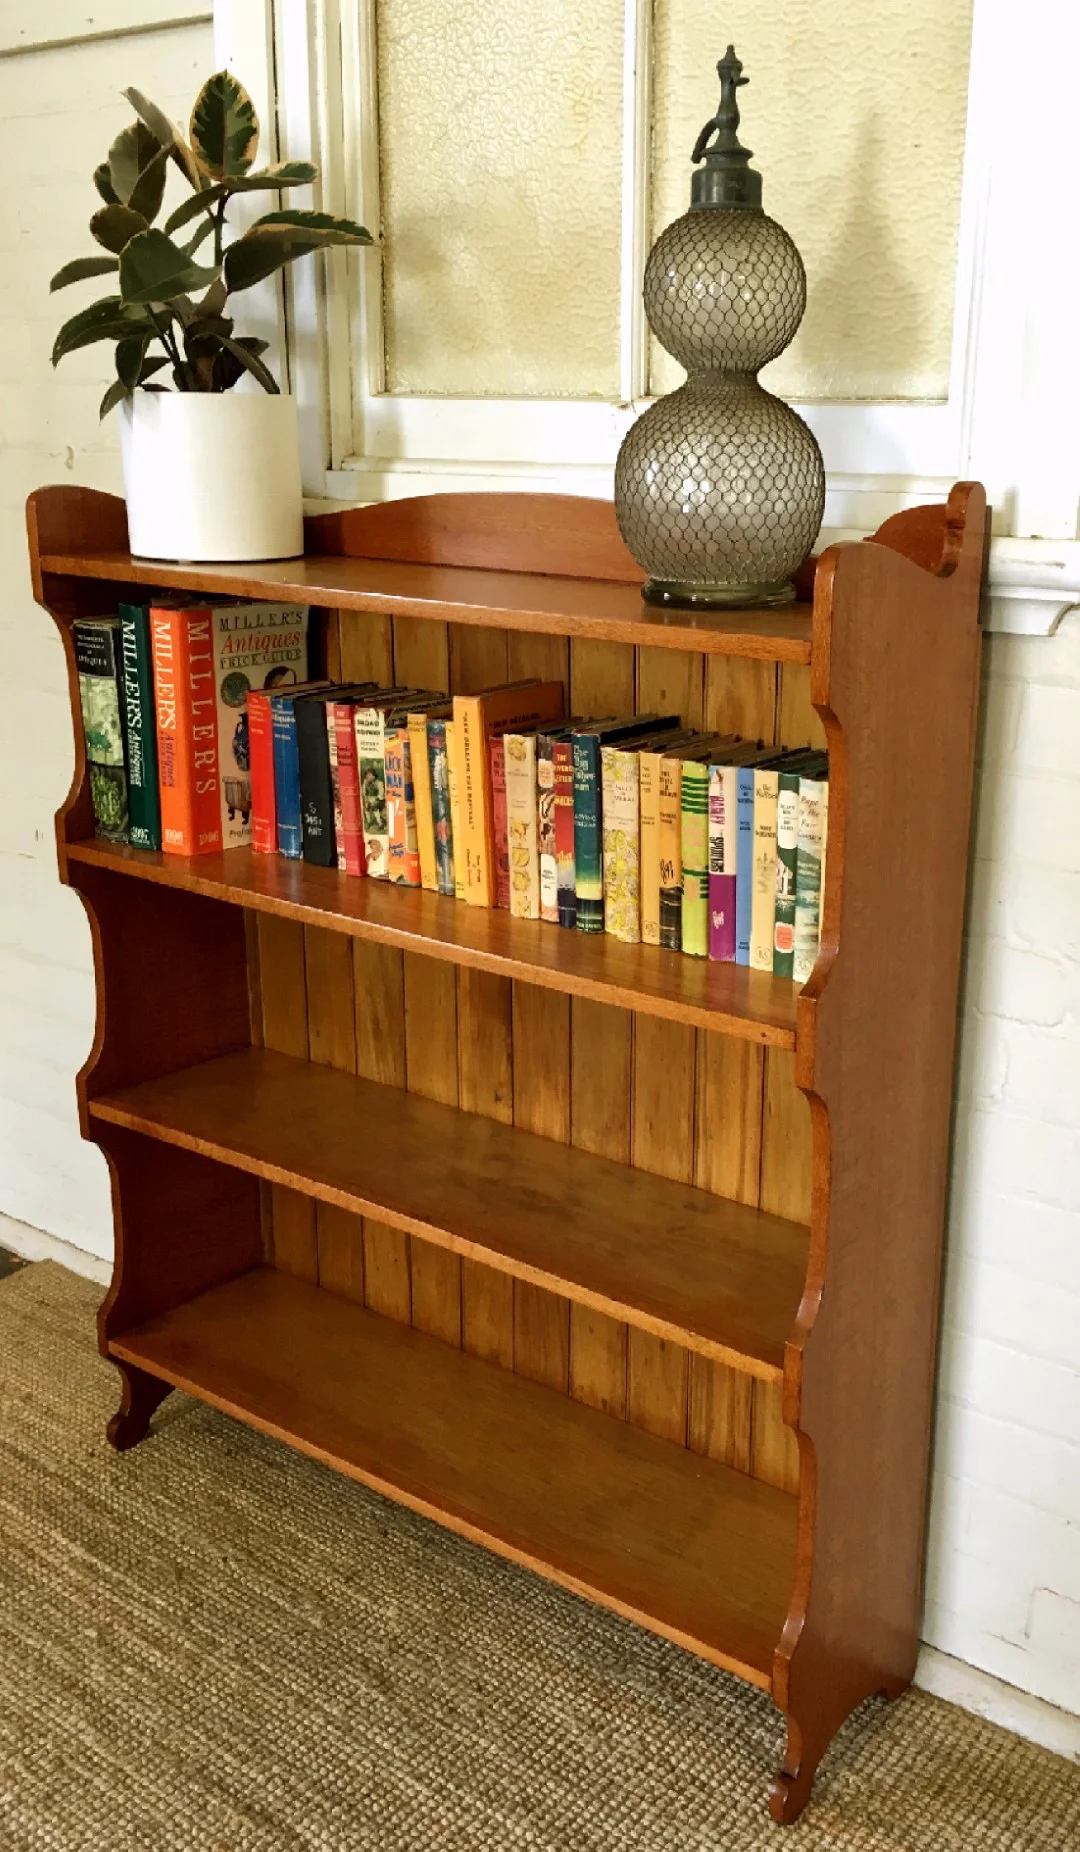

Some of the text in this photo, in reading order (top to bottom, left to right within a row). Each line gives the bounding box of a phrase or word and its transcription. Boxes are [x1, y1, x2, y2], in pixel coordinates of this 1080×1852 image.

[219, 611, 303, 632] MILLER'S
[221, 631, 301, 656] Antiques
[220, 649, 301, 669] PRICE GUIDE
[154, 619, 177, 788] MILLER'S Antiques
[187, 620, 217, 795] MILLER'S
